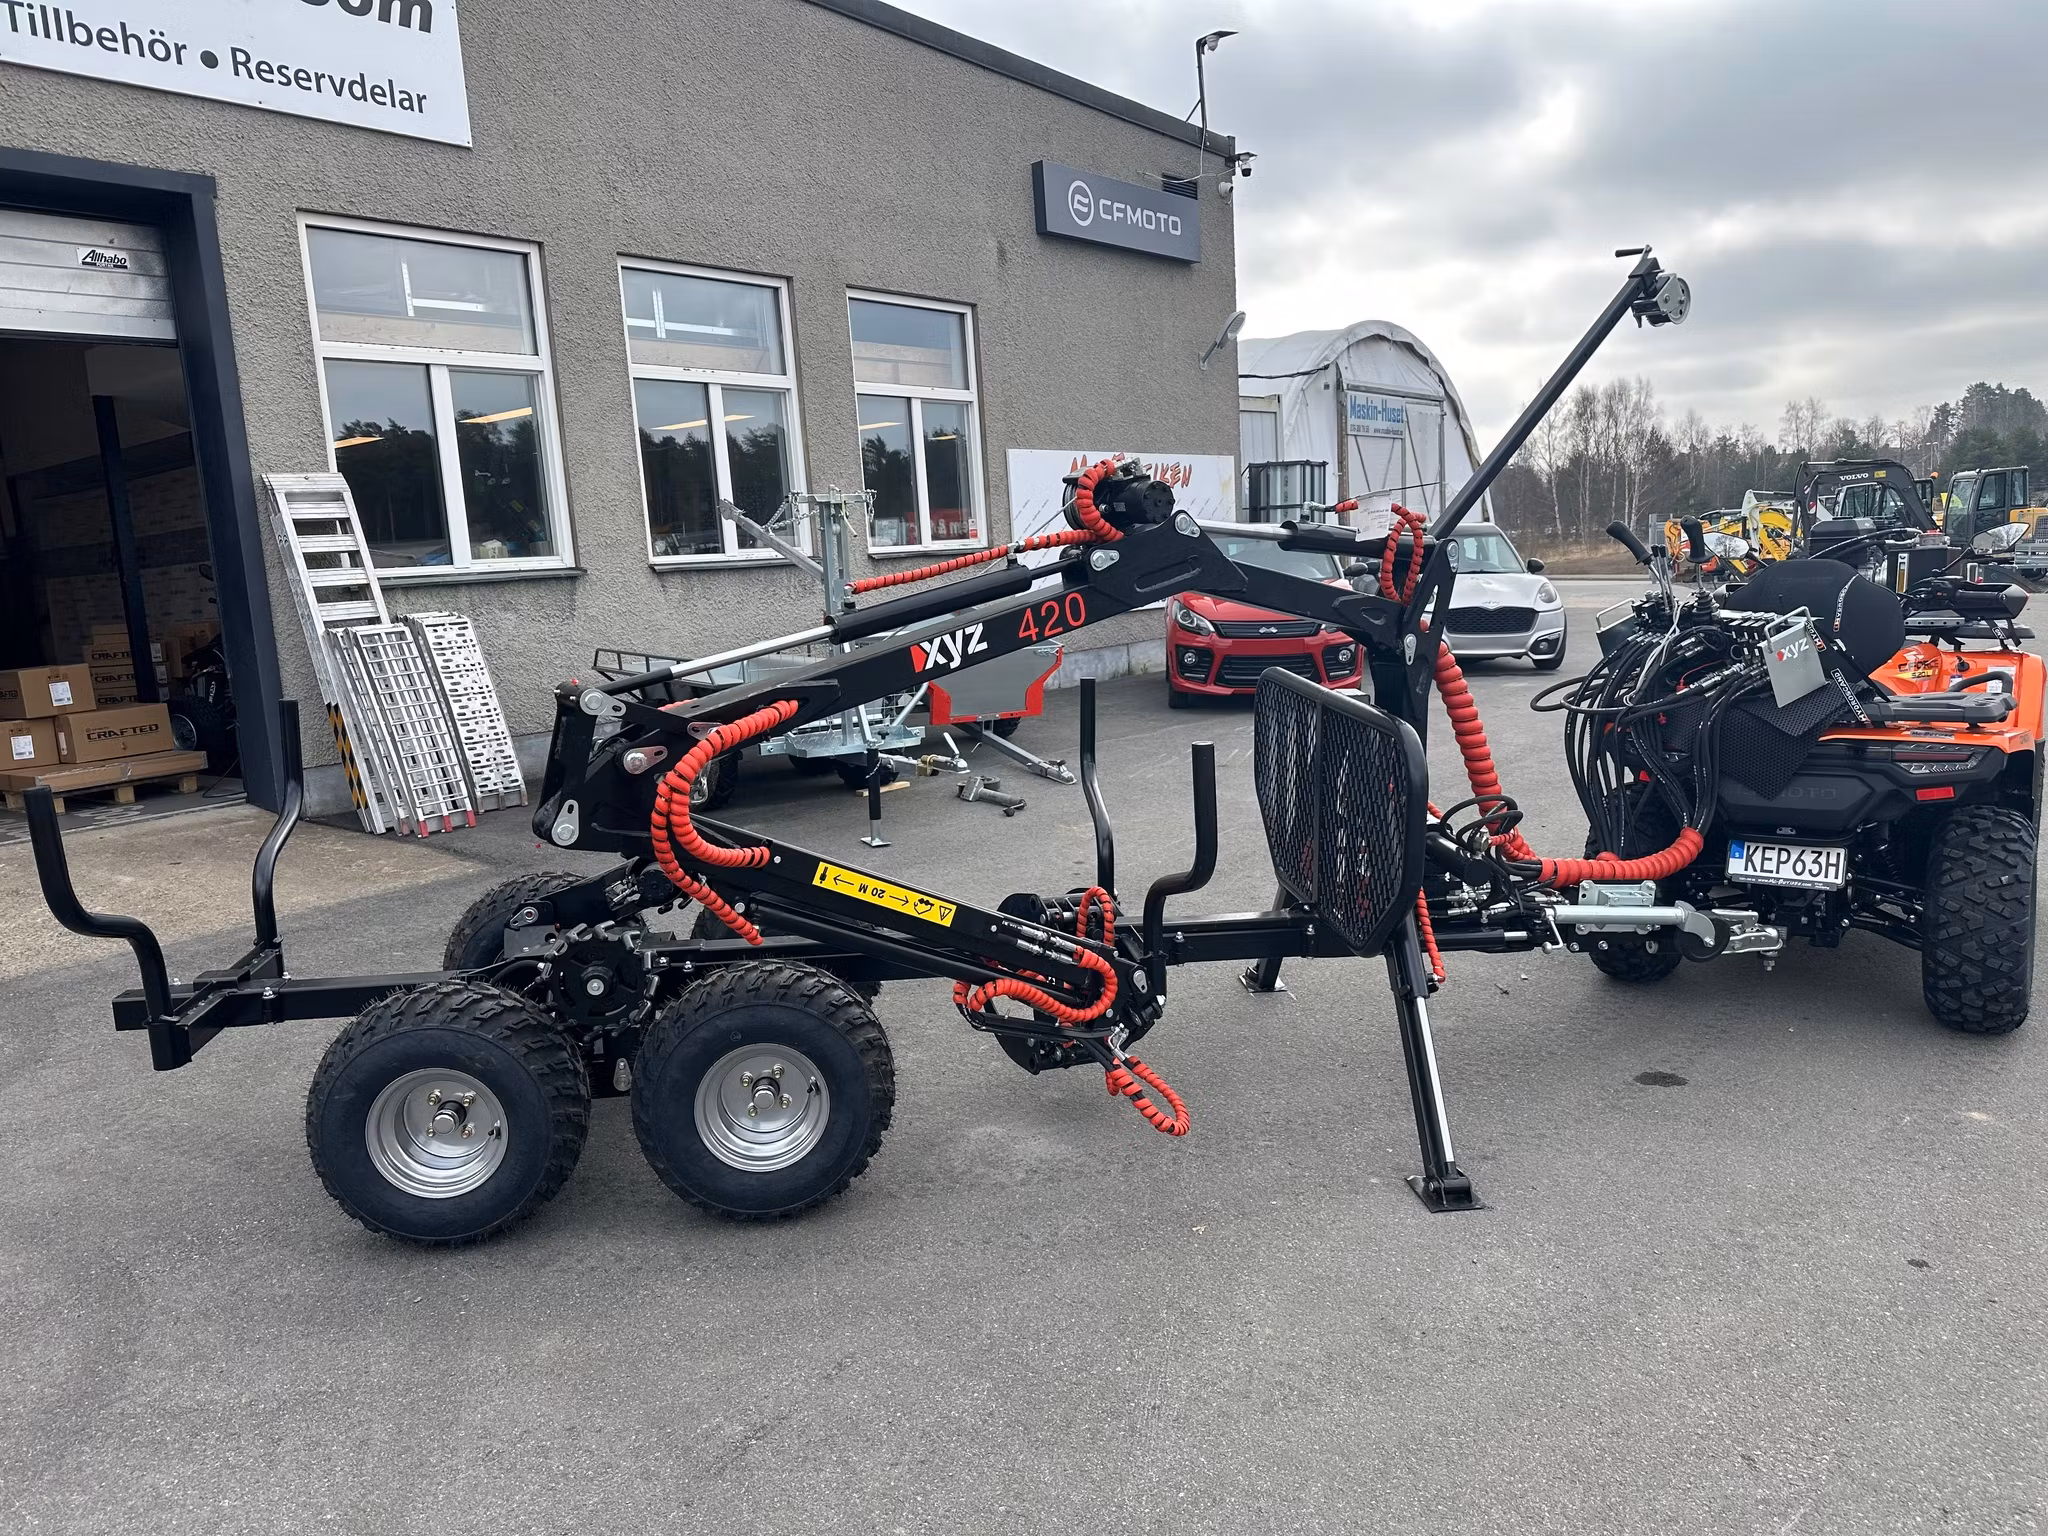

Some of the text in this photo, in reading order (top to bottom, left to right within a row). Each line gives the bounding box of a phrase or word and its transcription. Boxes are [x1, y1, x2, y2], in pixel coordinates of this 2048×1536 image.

[2, 0, 427, 114] Tillbehör Reservdelar
[1099, 198, 1182, 236] CFMOTO
[82, 249, 127, 265] Allhabo
[1350, 394, 1404, 424] Maskin-Huset
[1839, 472, 1869, 481] VOLVO
[918, 591, 1087, 670] xyz 420
[1782, 637, 1810, 661] xyz
[98, 695, 137, 704] CRAFT
[1833, 671, 1867, 721] HYDROSCAND
[86, 723, 160, 741] CRAFTED
[1744, 844, 1841, 880] KEP63H
[858, 882, 887, 899] 20 M
